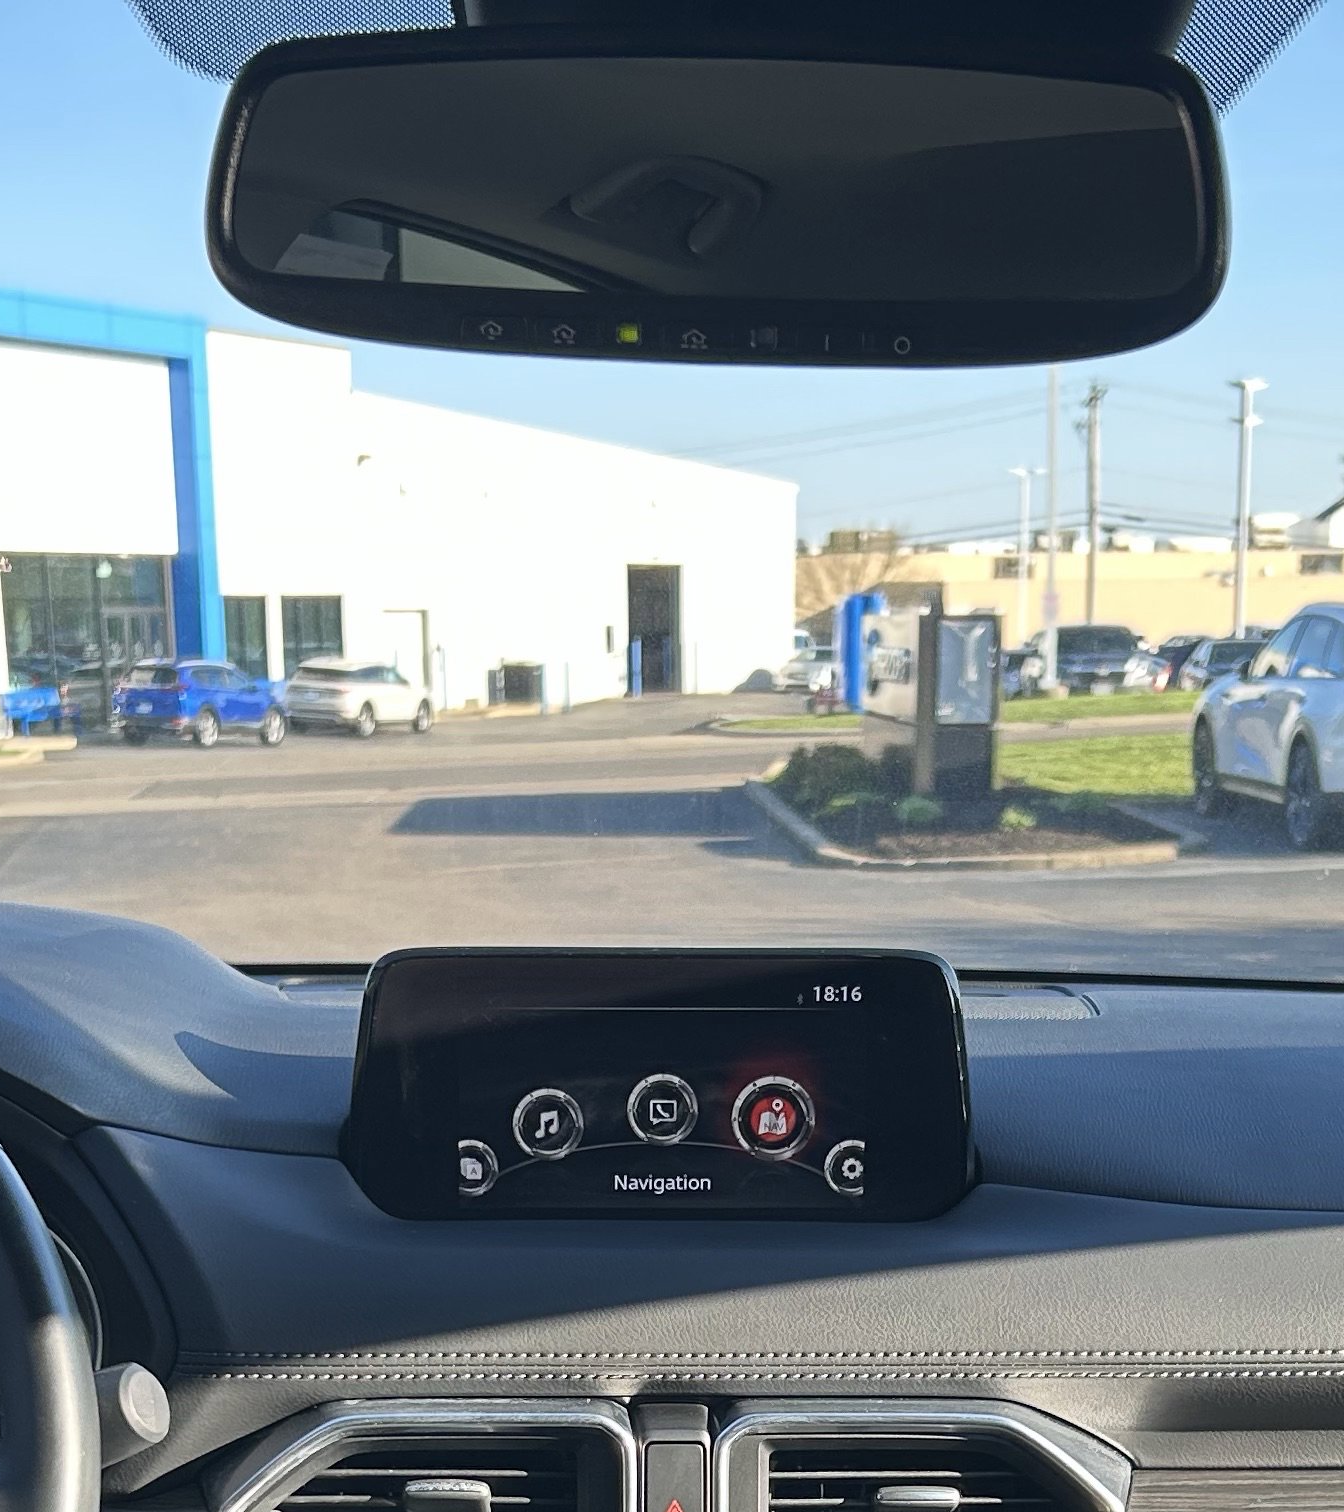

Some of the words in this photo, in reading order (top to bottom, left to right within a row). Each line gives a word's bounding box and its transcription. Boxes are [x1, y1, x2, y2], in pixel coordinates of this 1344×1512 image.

[812, 984, 862, 1002] 18:16
[763, 1121, 785, 1132] NAV
[613, 1174, 712, 1195] Navigation
